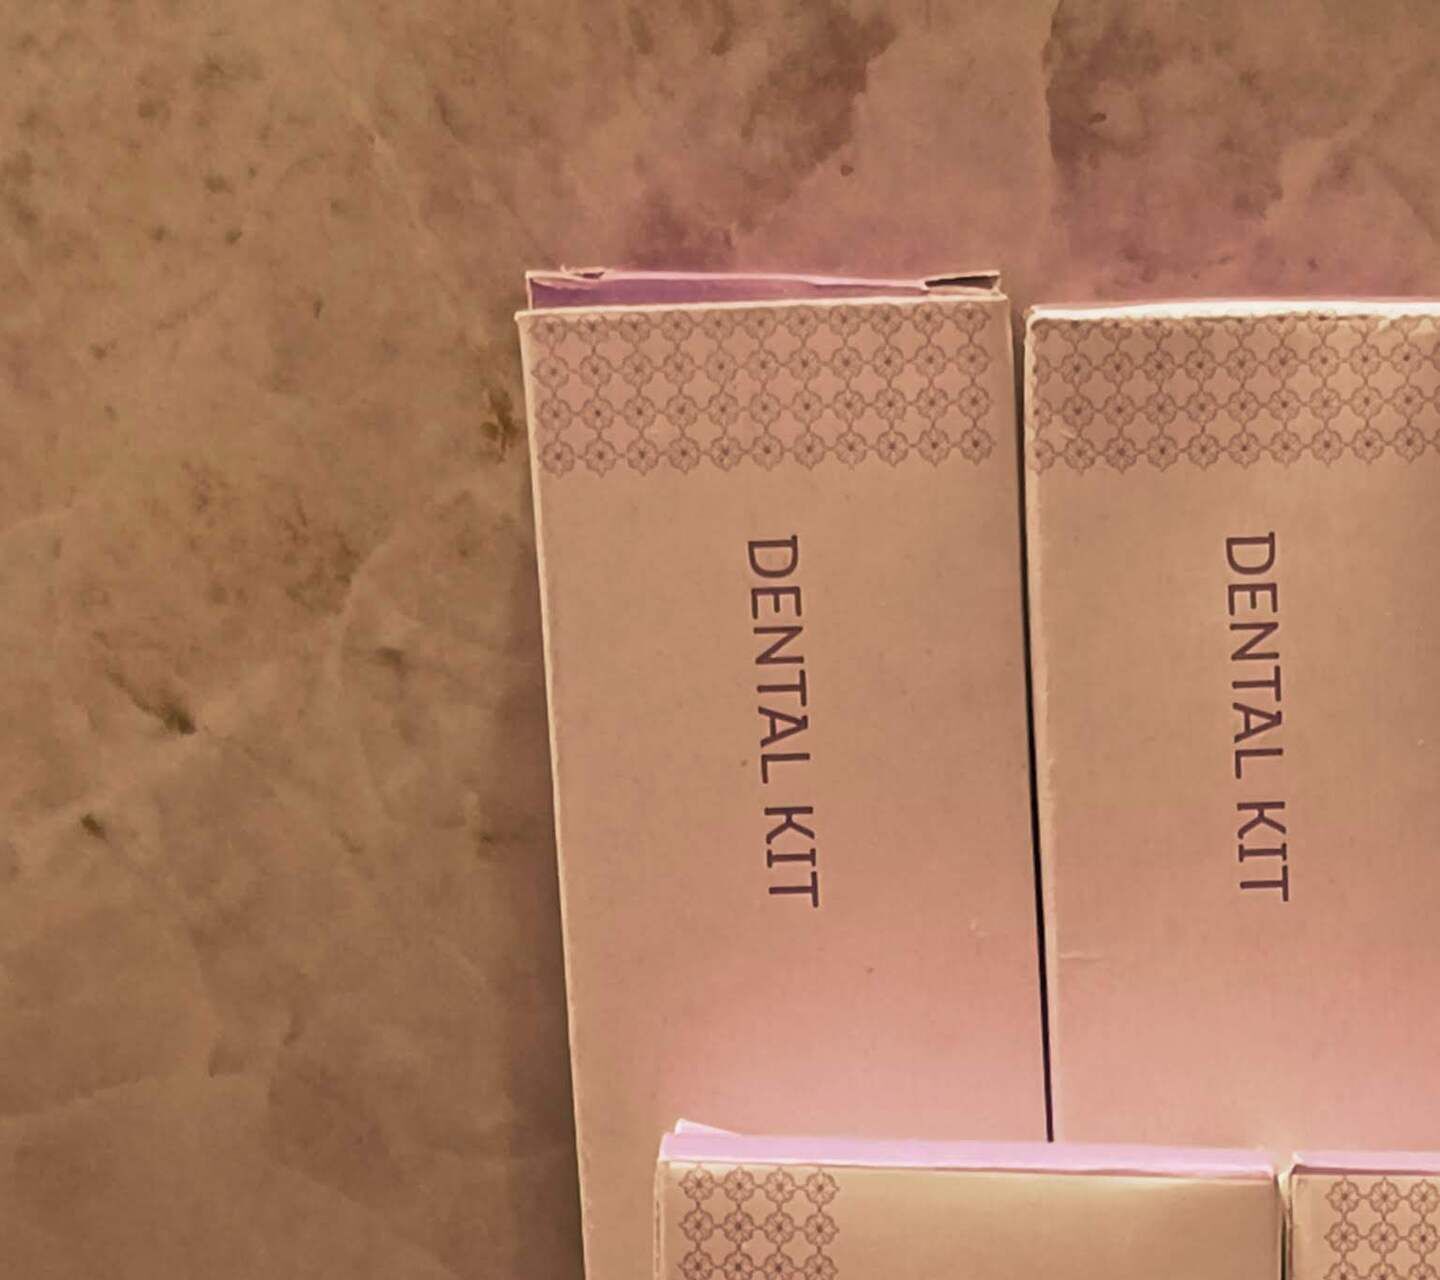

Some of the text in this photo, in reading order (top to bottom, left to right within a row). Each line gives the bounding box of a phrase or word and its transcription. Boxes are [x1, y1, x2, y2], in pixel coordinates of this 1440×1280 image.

[747, 534, 819, 908] DENTAL KIT
[1225, 531, 1289, 902] DENTAL KIT
